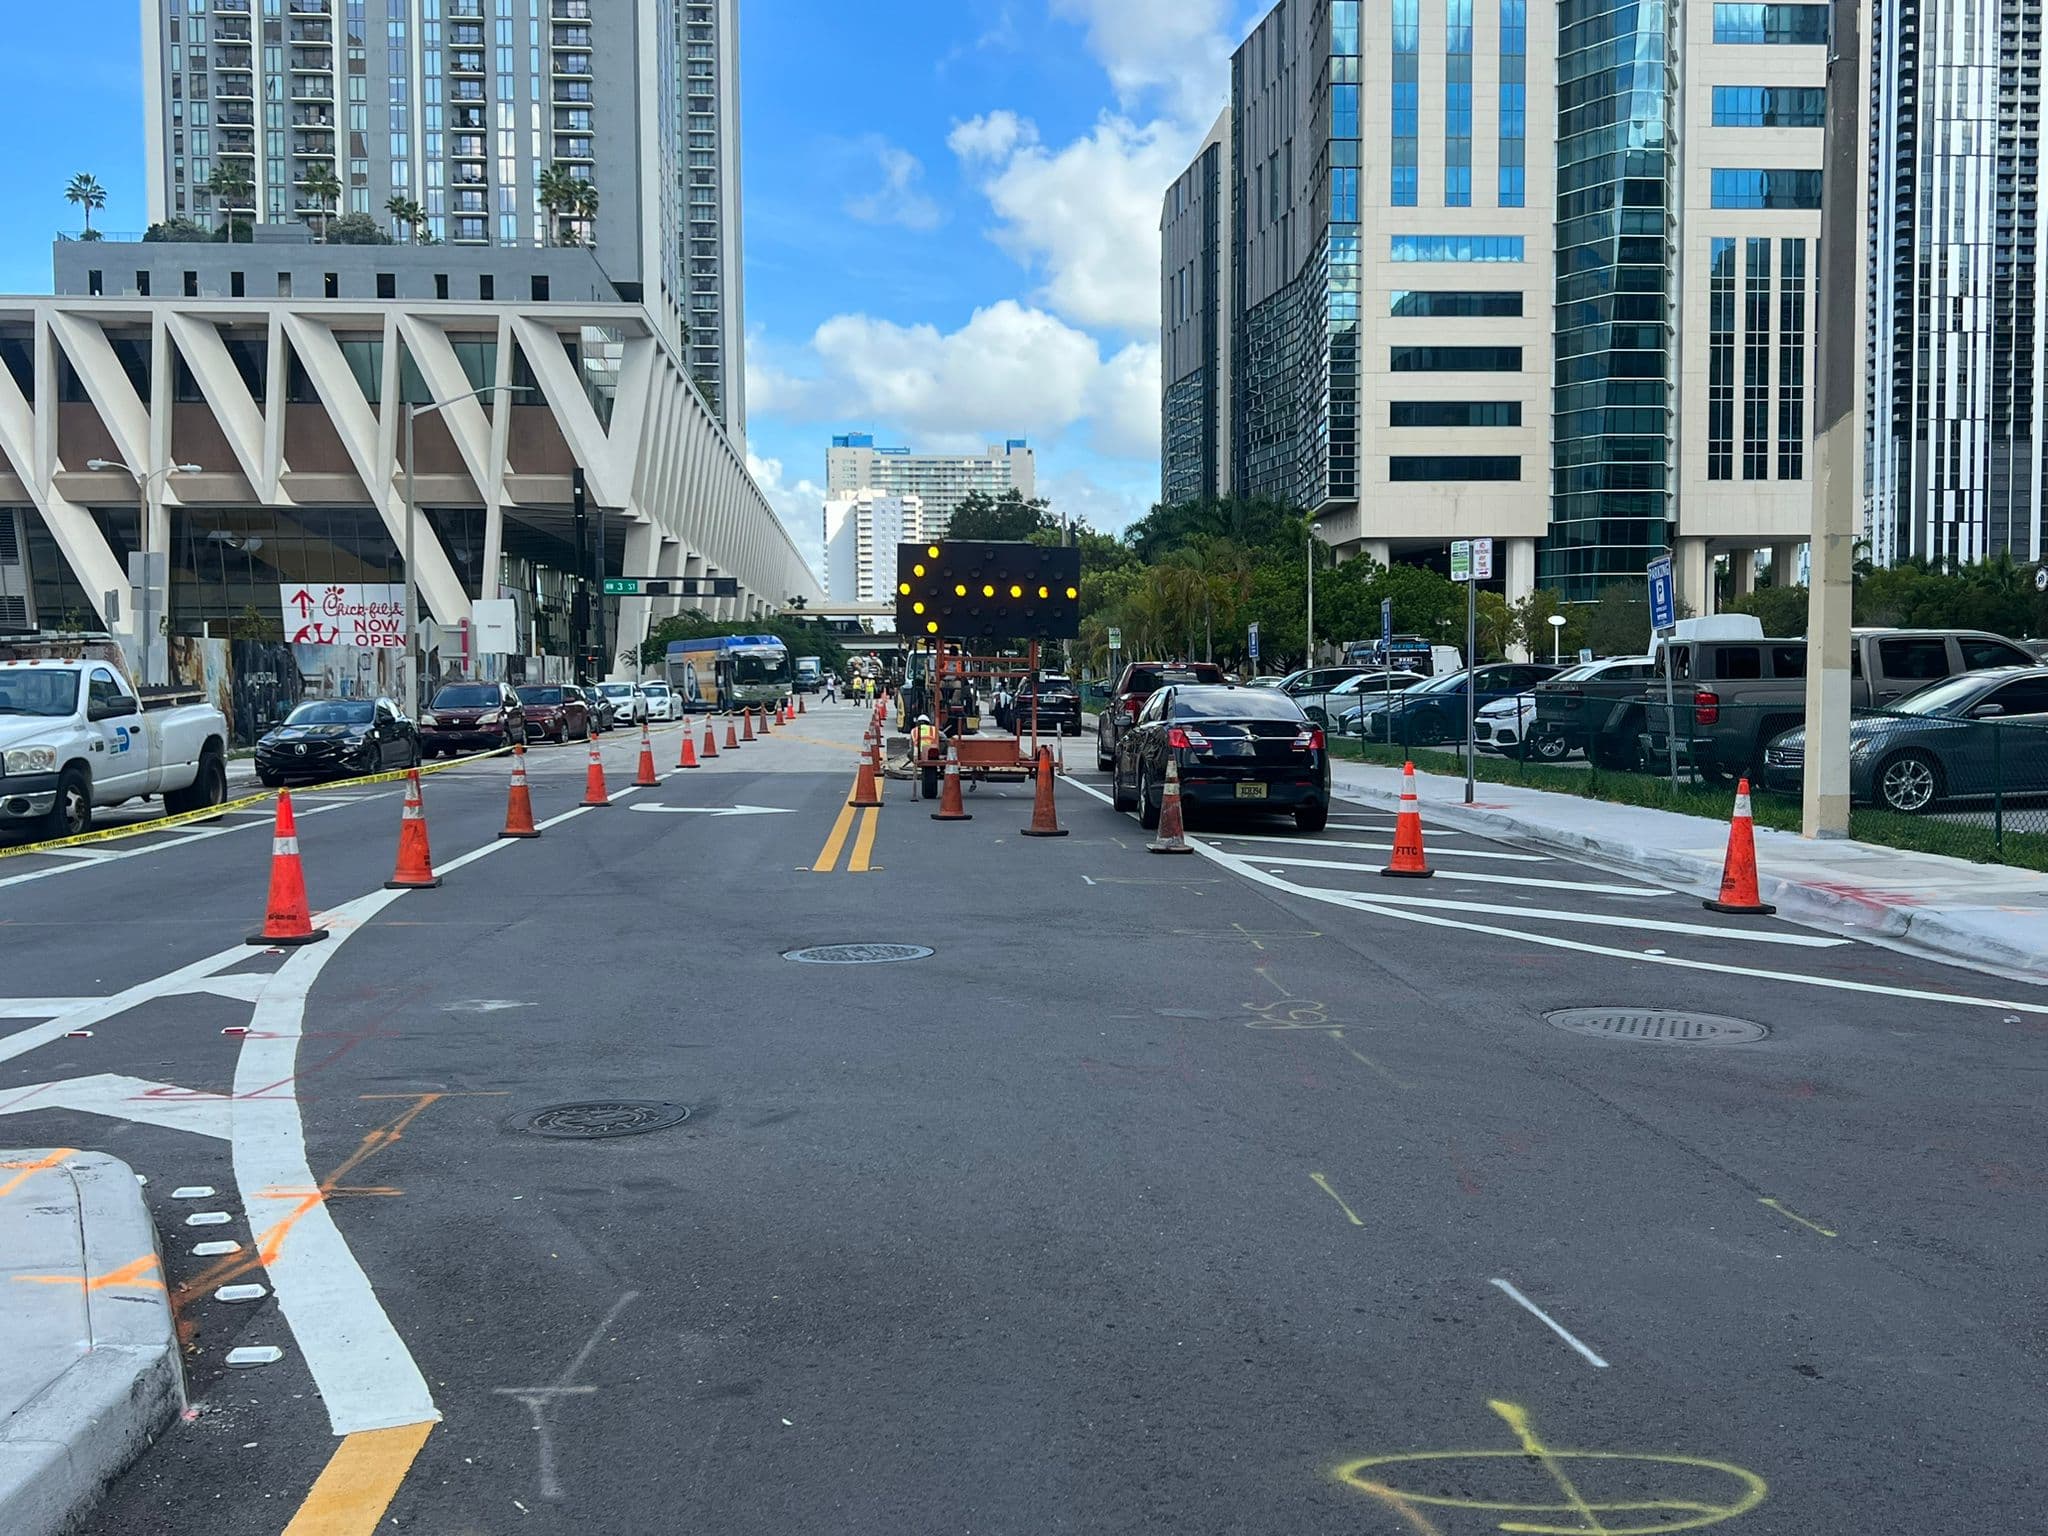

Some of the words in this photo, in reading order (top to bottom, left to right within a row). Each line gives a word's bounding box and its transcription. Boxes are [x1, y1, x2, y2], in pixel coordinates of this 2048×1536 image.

[1648, 563, 1669, 580] PARKING
[617, 582, 623, 591] 3
[628, 583, 636, 591] ST
[323, 592, 404, 618] Chick-fil-A
[354, 619, 400, 633] NOW
[355, 634, 407, 646] OPEN
